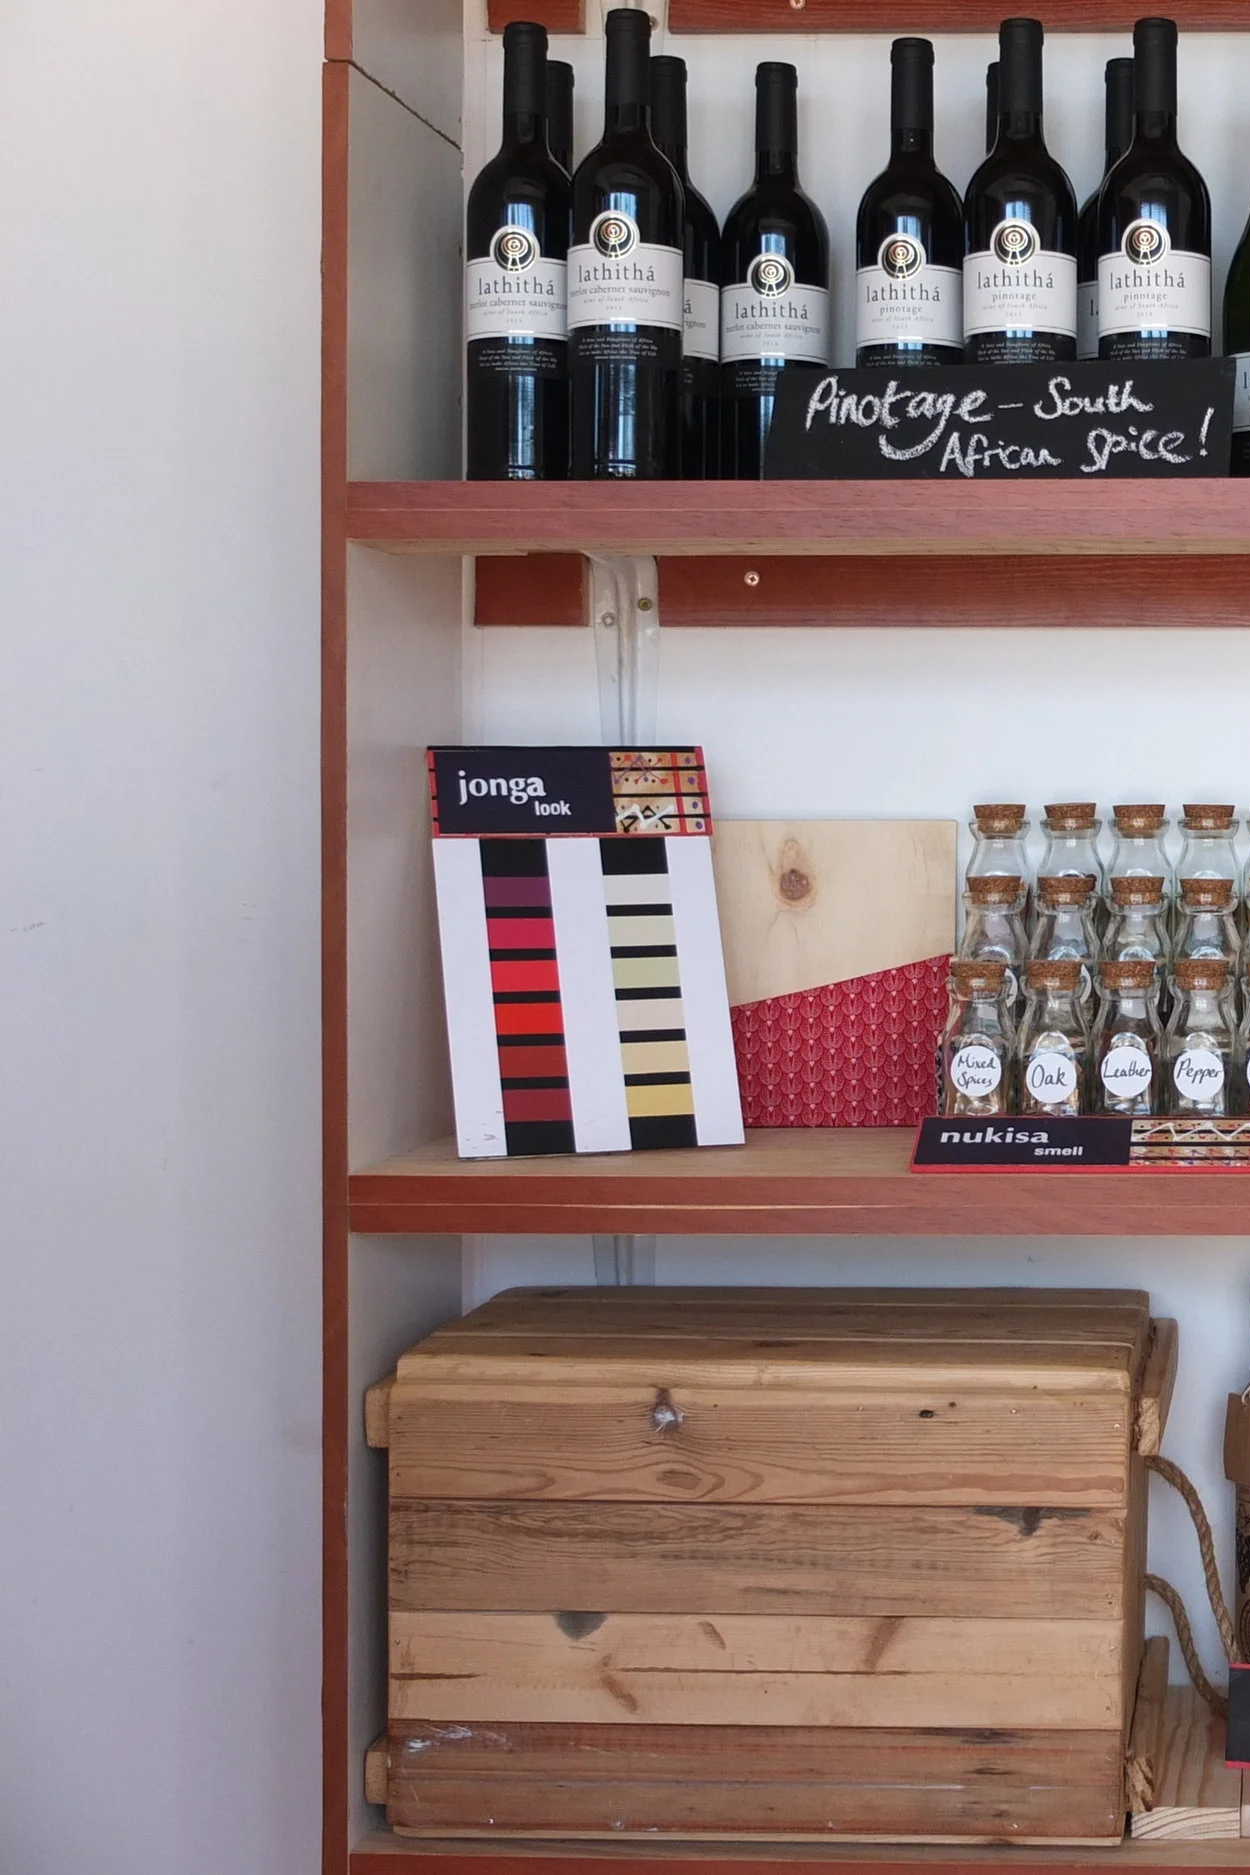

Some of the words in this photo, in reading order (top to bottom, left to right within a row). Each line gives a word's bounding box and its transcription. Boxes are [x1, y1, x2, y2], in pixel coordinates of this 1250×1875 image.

[579, 263, 655, 283] lathithá
[977, 269, 1054, 289] lathithá
[1110, 269, 1185, 290] lathithá
[479, 276, 555, 296] lathithá
[589, 285, 625, 295] cabernet
[866, 283, 941, 303] lathithá
[992, 292, 1037, 303] pinotage
[1124, 292, 1168, 304] pinotage
[735, 301, 808, 320] lathithá
[880, 304, 923, 316] pinotage
[805, 375, 994, 461] Pinotage
[1033, 376, 1154, 420] South
[939, 431, 1063, 478] African
[457, 771, 546, 805] jonga
[535, 800, 571, 816] look
[957, 1055, 997, 1070] Mixed
[1103, 1059, 1150, 1079] Leather
[1176, 1059, 1222, 1084] Pepper
[957, 1070, 993, 1088] Spices
[1031, 1064, 1069, 1088] Oak
[940, 1126, 1049, 1144] nukisa
[1034, 1145, 1083, 1157] smell
